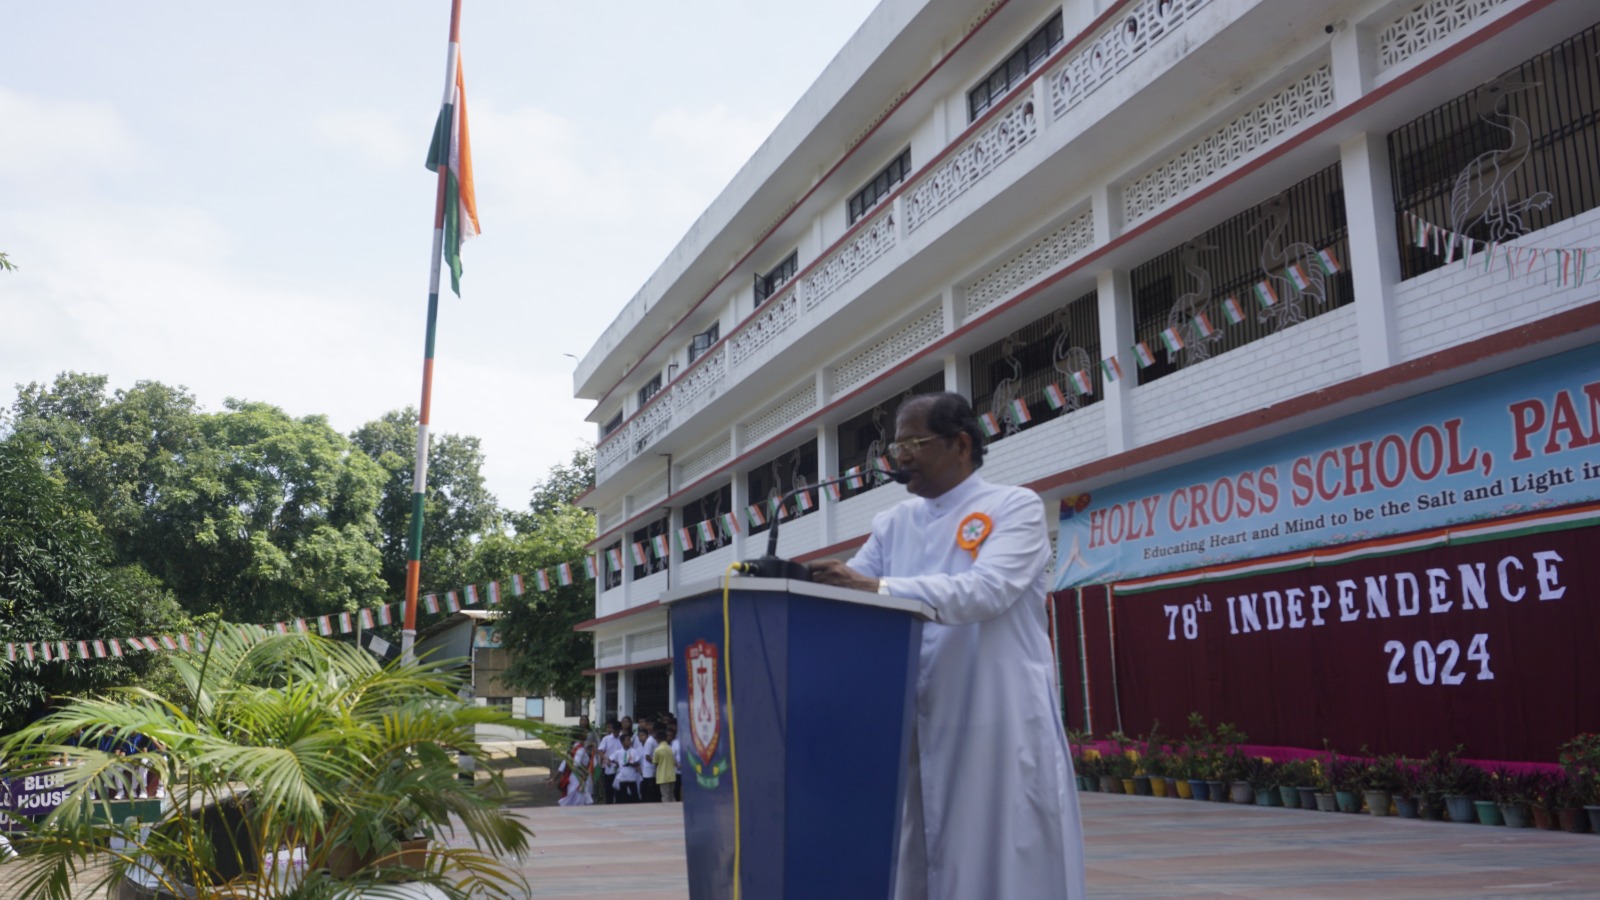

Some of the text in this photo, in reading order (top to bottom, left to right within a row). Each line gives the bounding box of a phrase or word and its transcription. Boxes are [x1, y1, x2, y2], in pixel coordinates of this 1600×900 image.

[1088, 495, 1161, 549] HOLY
[1168, 466, 1279, 533] CROSS
[1291, 418, 1492, 508] SCHOOL,
[1143, 538, 1205, 560] Educating
[1210, 530, 1247, 548] Heart
[1252, 523, 1279, 541] and
[1285, 514, 1325, 535] Mind
[1331, 513, 1348, 526] to
[1353, 507, 1375, 522] be
[1381, 499, 1411, 518] the
[1417, 491, 1457, 511] Salt
[1463, 480, 1504, 502] and
[1511, 467, 1574, 494] Light
[1164, 549, 1567, 641] 78th INDEPENDENCE
[1384, 633, 1495, 685] 2024
[17, 790, 71, 808] HOUSE
[24, 773, 65, 791] BLUE
